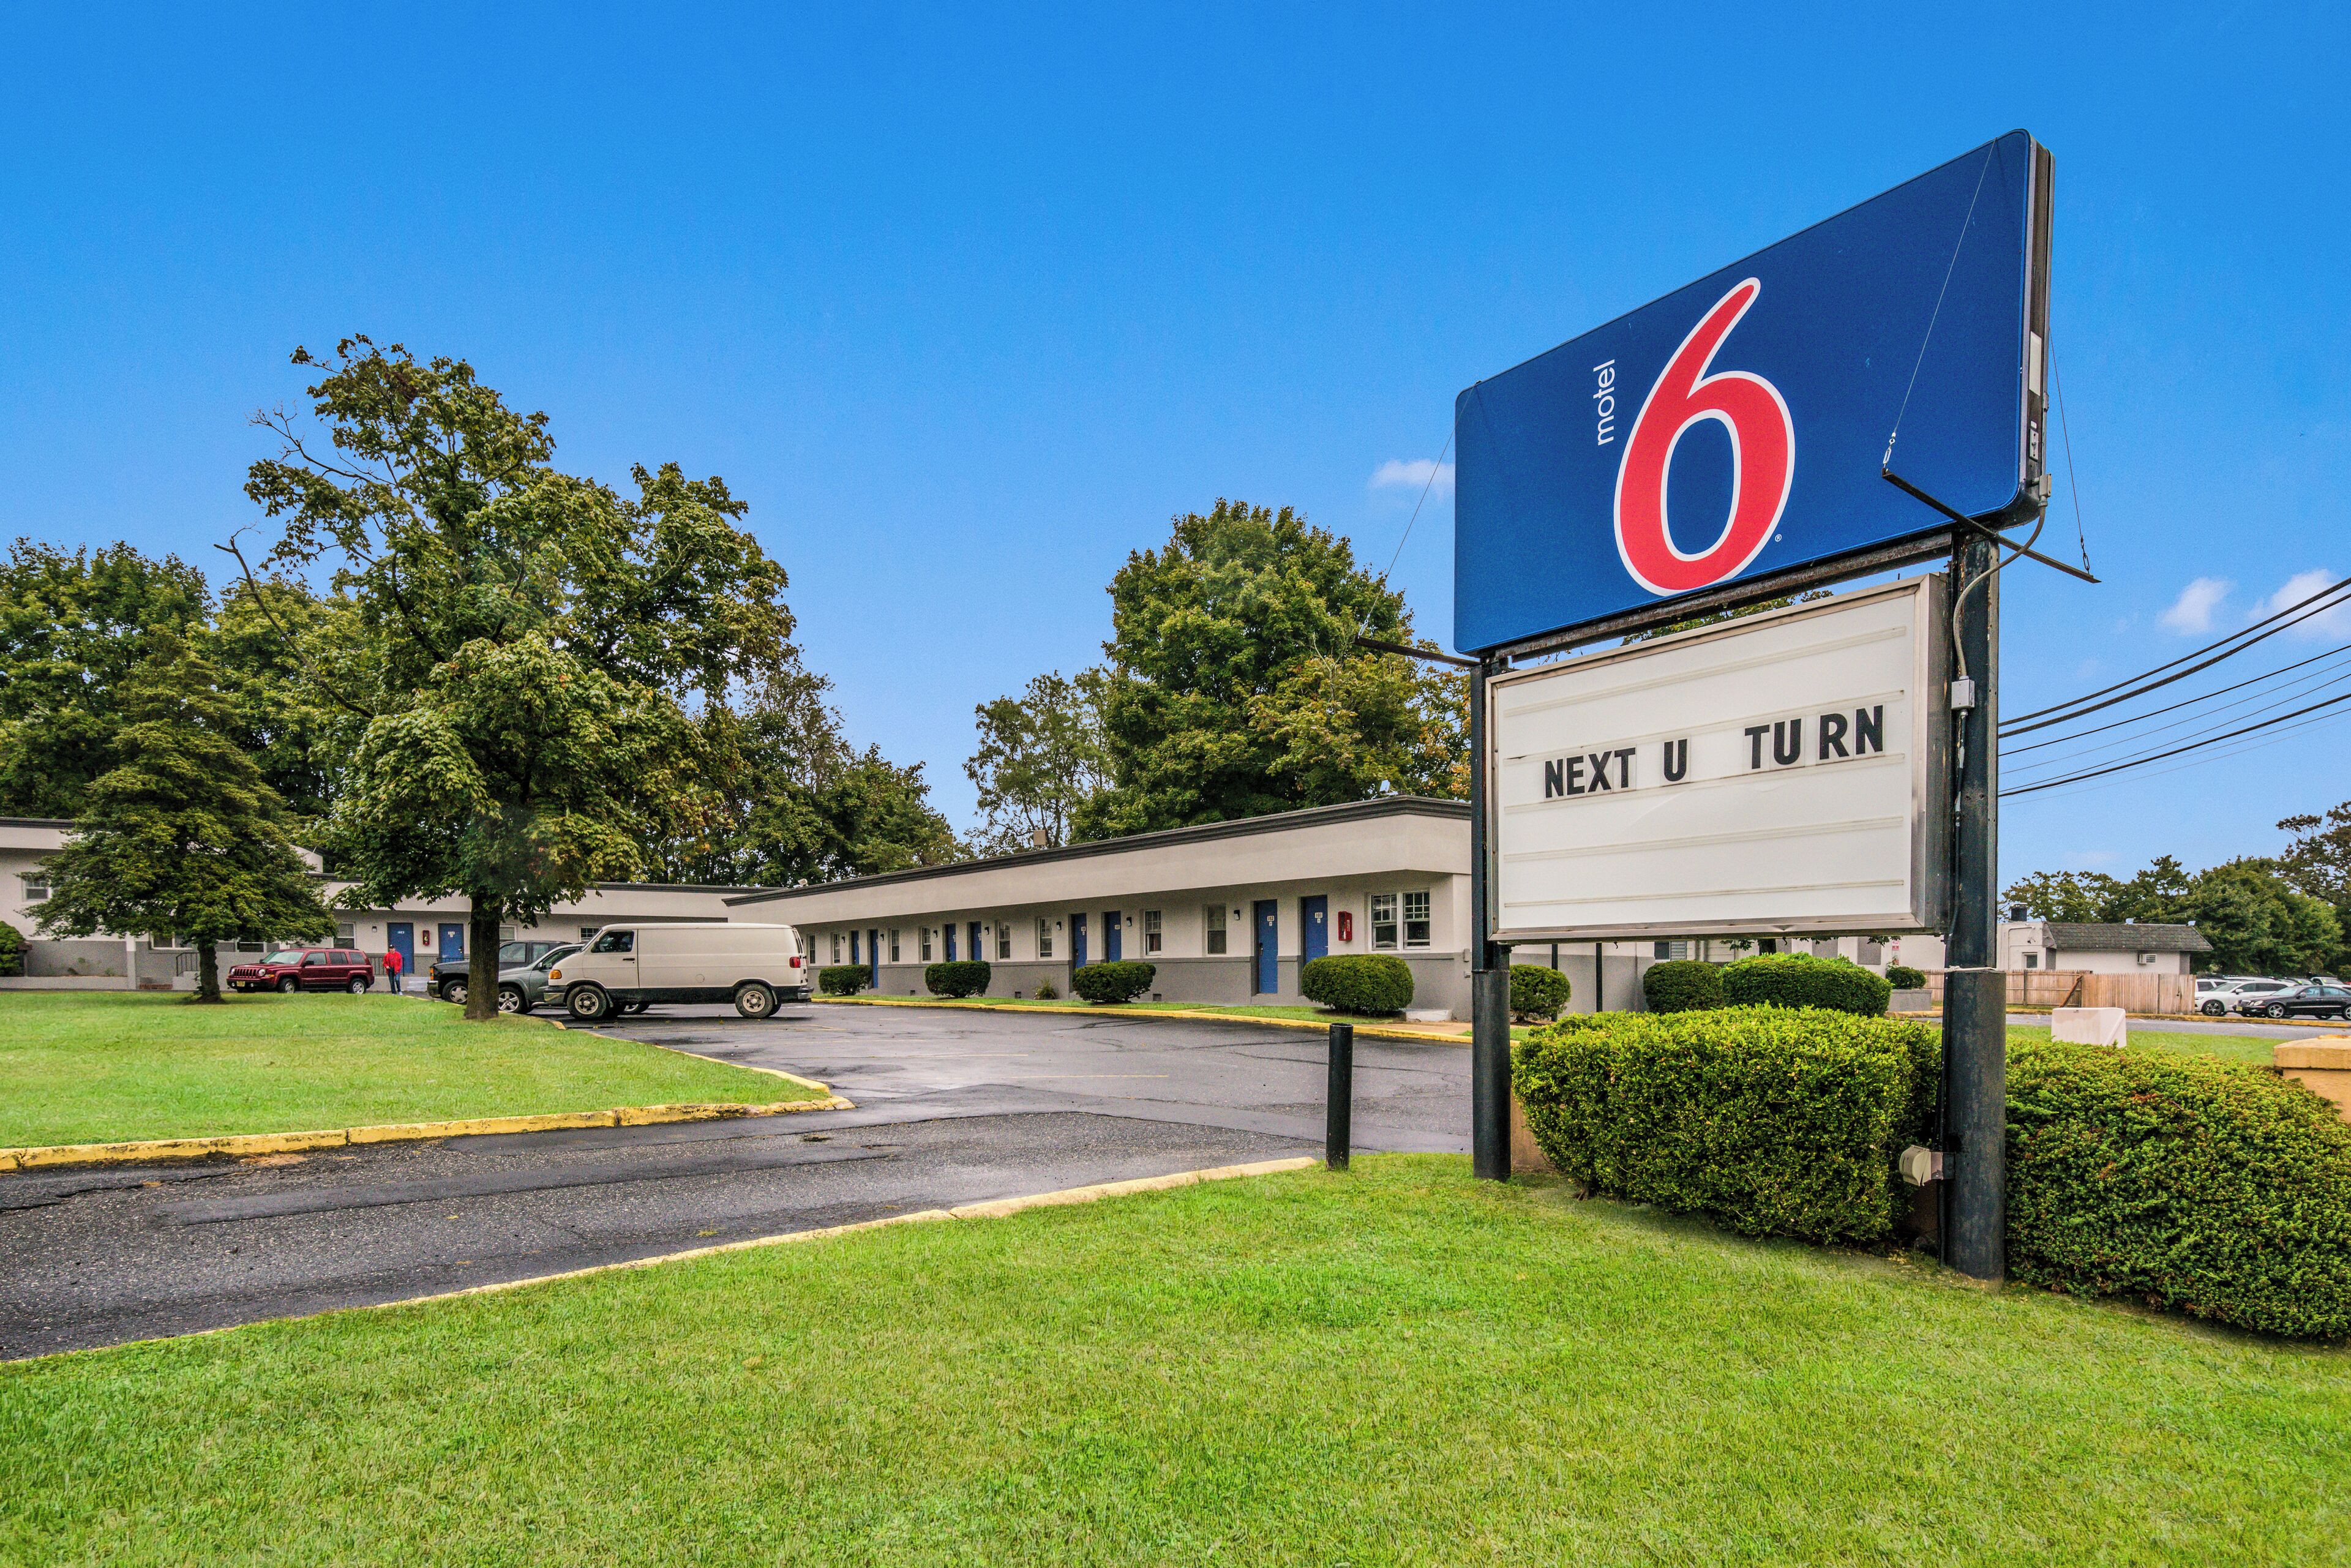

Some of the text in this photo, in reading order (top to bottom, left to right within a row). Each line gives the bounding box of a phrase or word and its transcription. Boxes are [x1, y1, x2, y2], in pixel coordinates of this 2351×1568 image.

[1593, 277, 1795, 595] motel 6
[1545, 705, 1884, 798] NEXT U TURN
